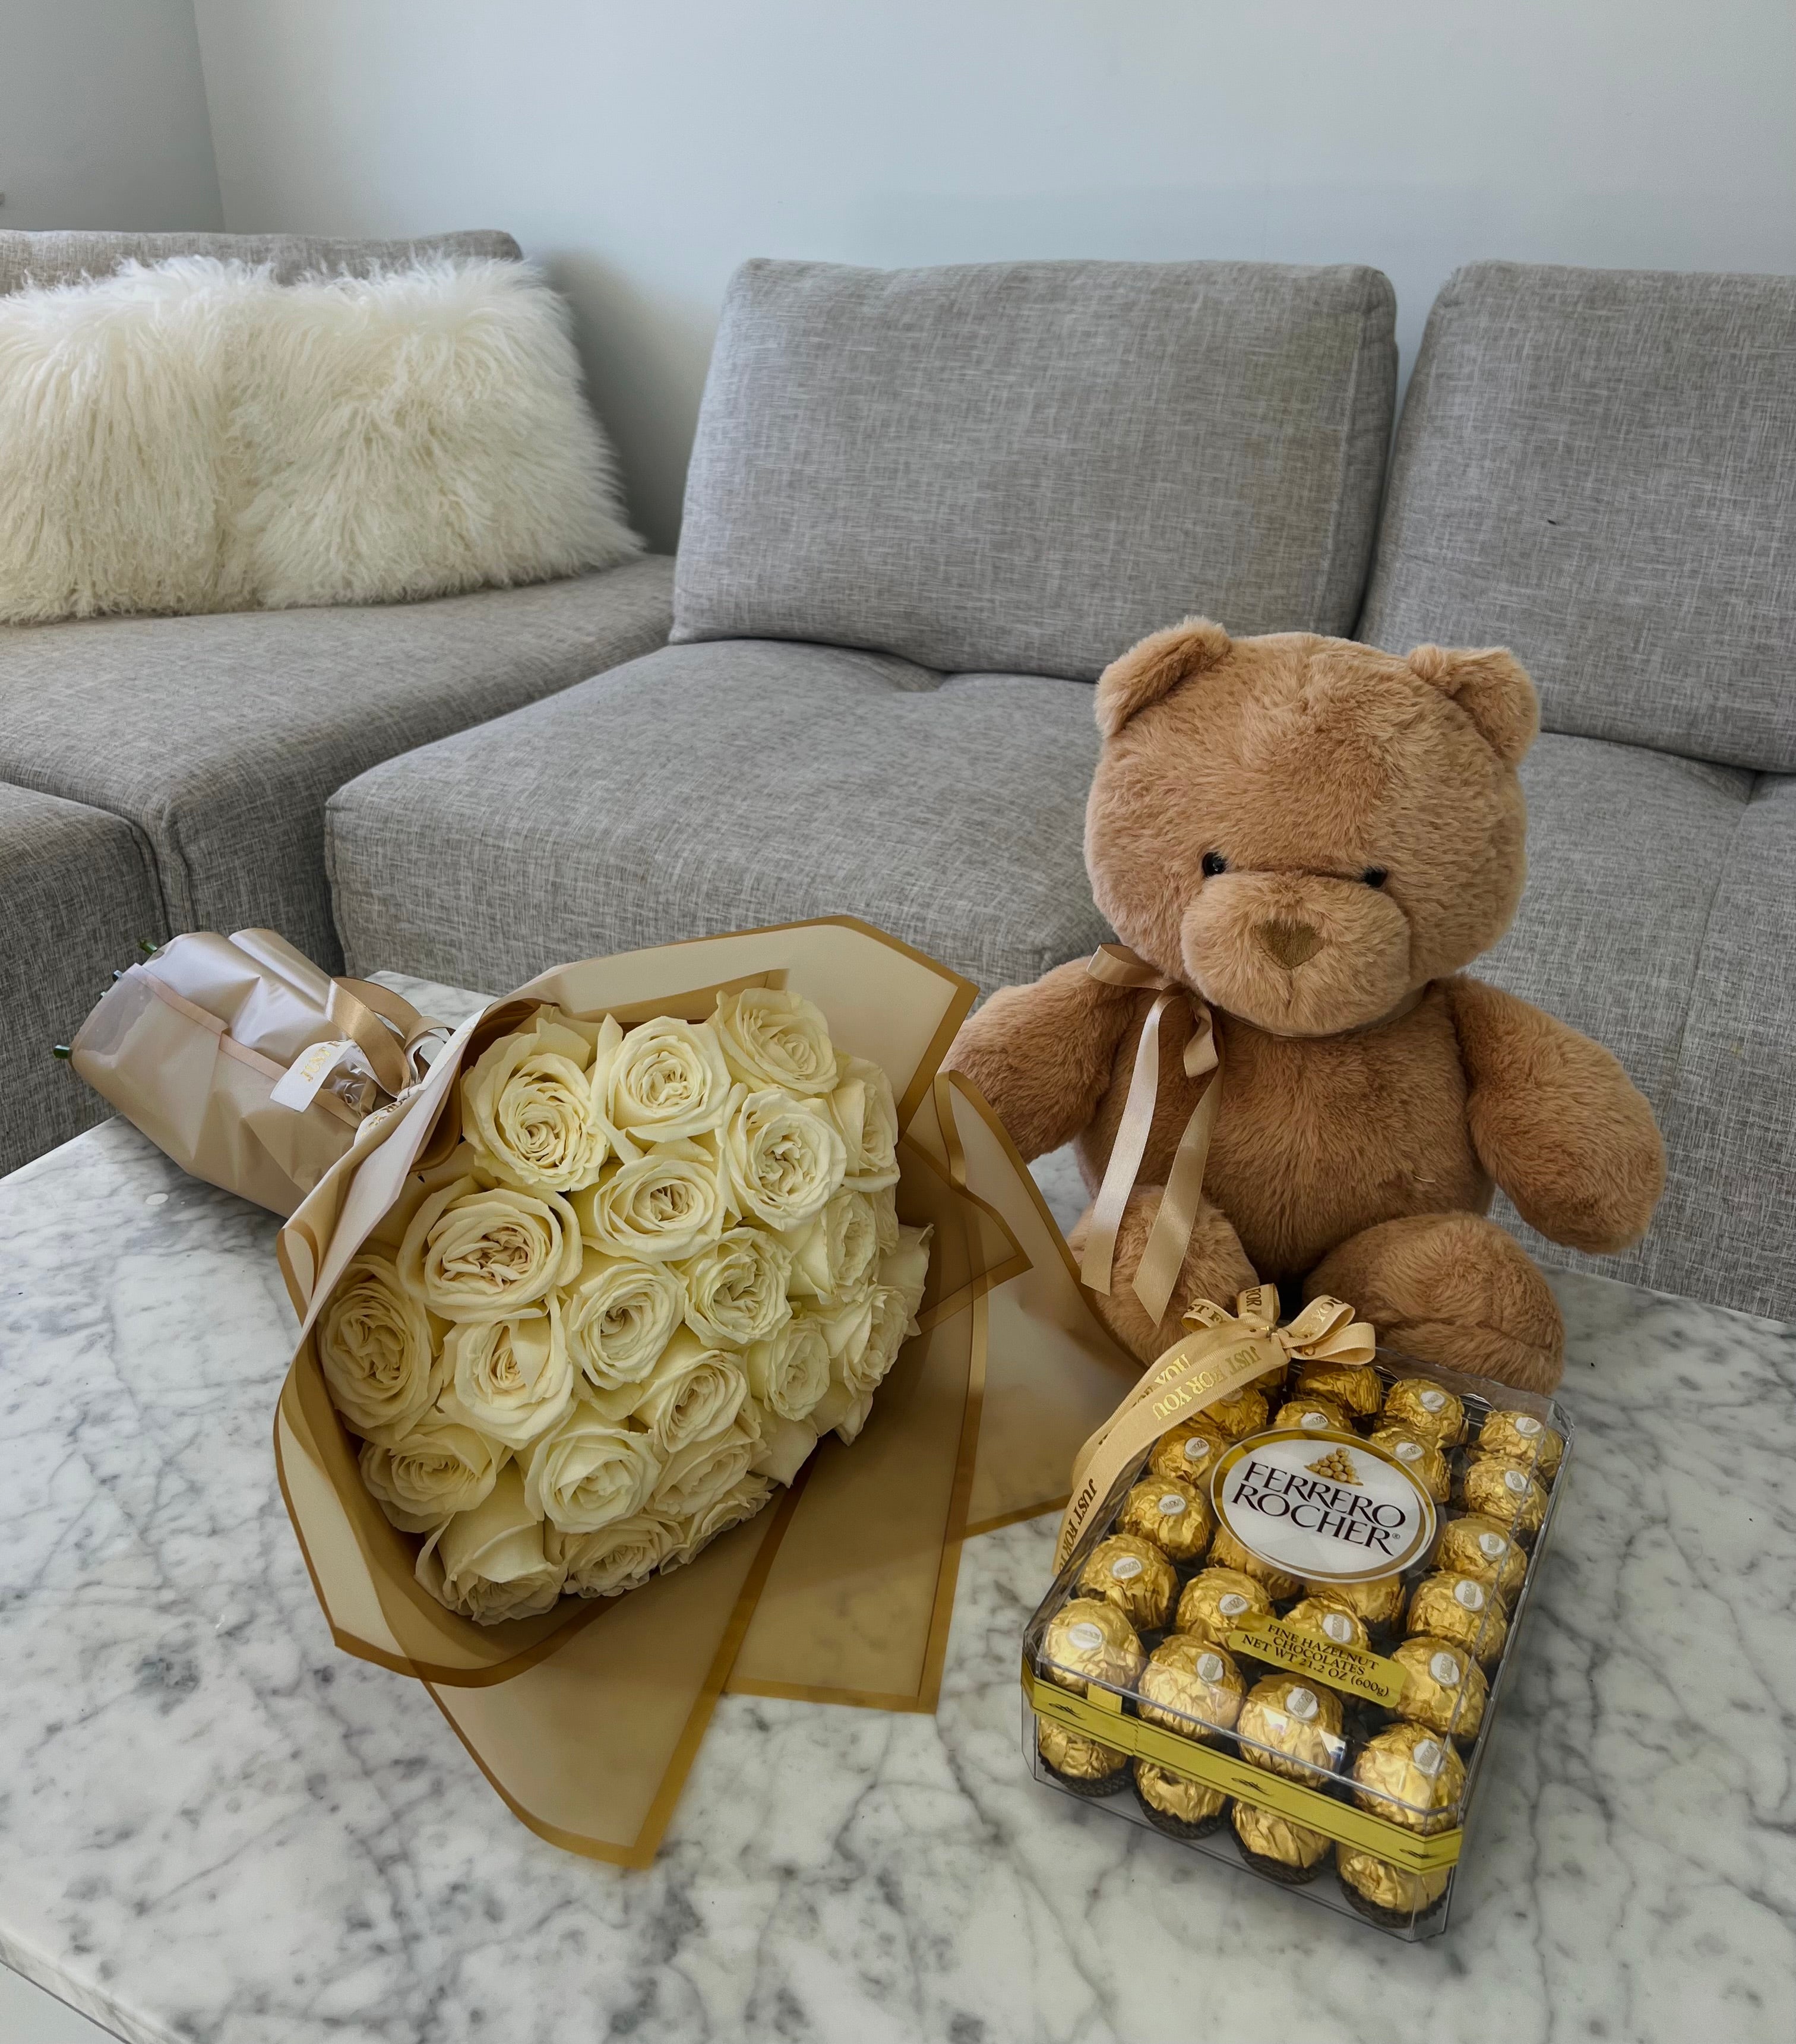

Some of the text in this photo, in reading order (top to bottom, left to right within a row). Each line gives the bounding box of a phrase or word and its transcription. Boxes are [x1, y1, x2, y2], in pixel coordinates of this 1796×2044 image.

[1245, 1287, 1263, 1307] FOR
[1225, 1345, 1262, 1375] JUST
[1185, 1365, 1228, 1395] FOR
[1152, 1386, 1193, 1420] YOU
[1073, 1478, 1098, 1526] JUST
[1242, 1461, 1406, 1528] FERRERO
[1062, 1518, 1079, 1555] FOR
[1241, 1634, 1389, 1697] NET WT 21.2 OZ (600g)
[1268, 1624, 1380, 1670] FINE HAZELNUT
[1273, 1637, 1365, 1676] CHOCOLATES
